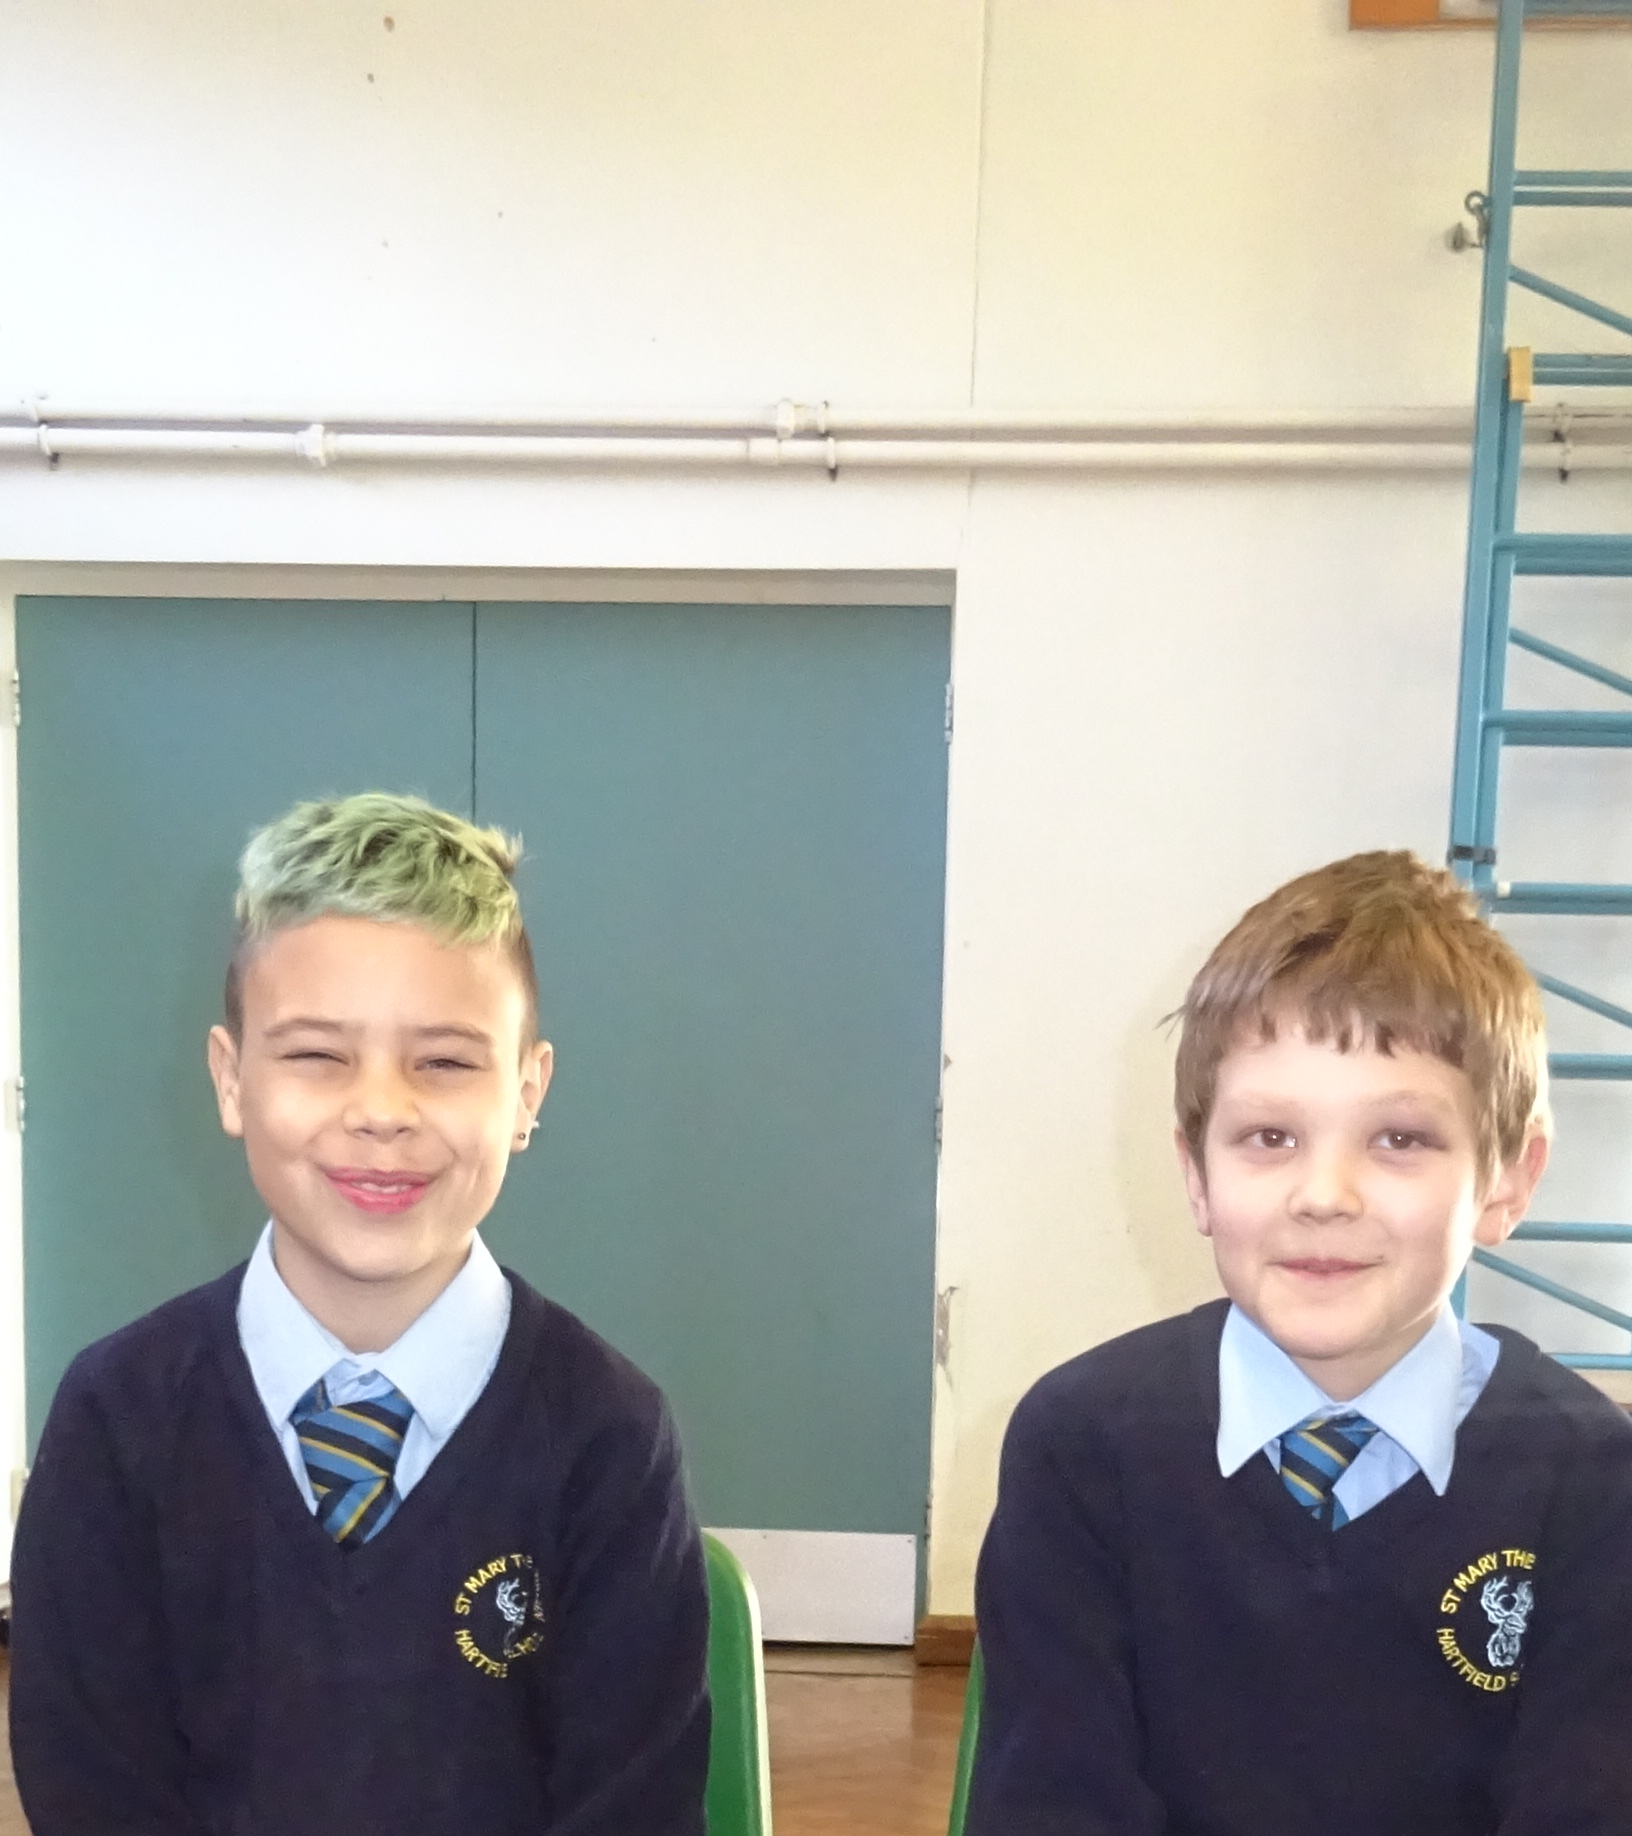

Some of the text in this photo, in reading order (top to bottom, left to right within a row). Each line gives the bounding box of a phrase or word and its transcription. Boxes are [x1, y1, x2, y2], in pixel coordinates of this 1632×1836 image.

[454, 1591, 473, 1616] ST
[464, 1556, 507, 1594] MARY
[1440, 1548, 1537, 1614] ST MARY THE
[1436, 1627, 1507, 1692] HARTFIELD
